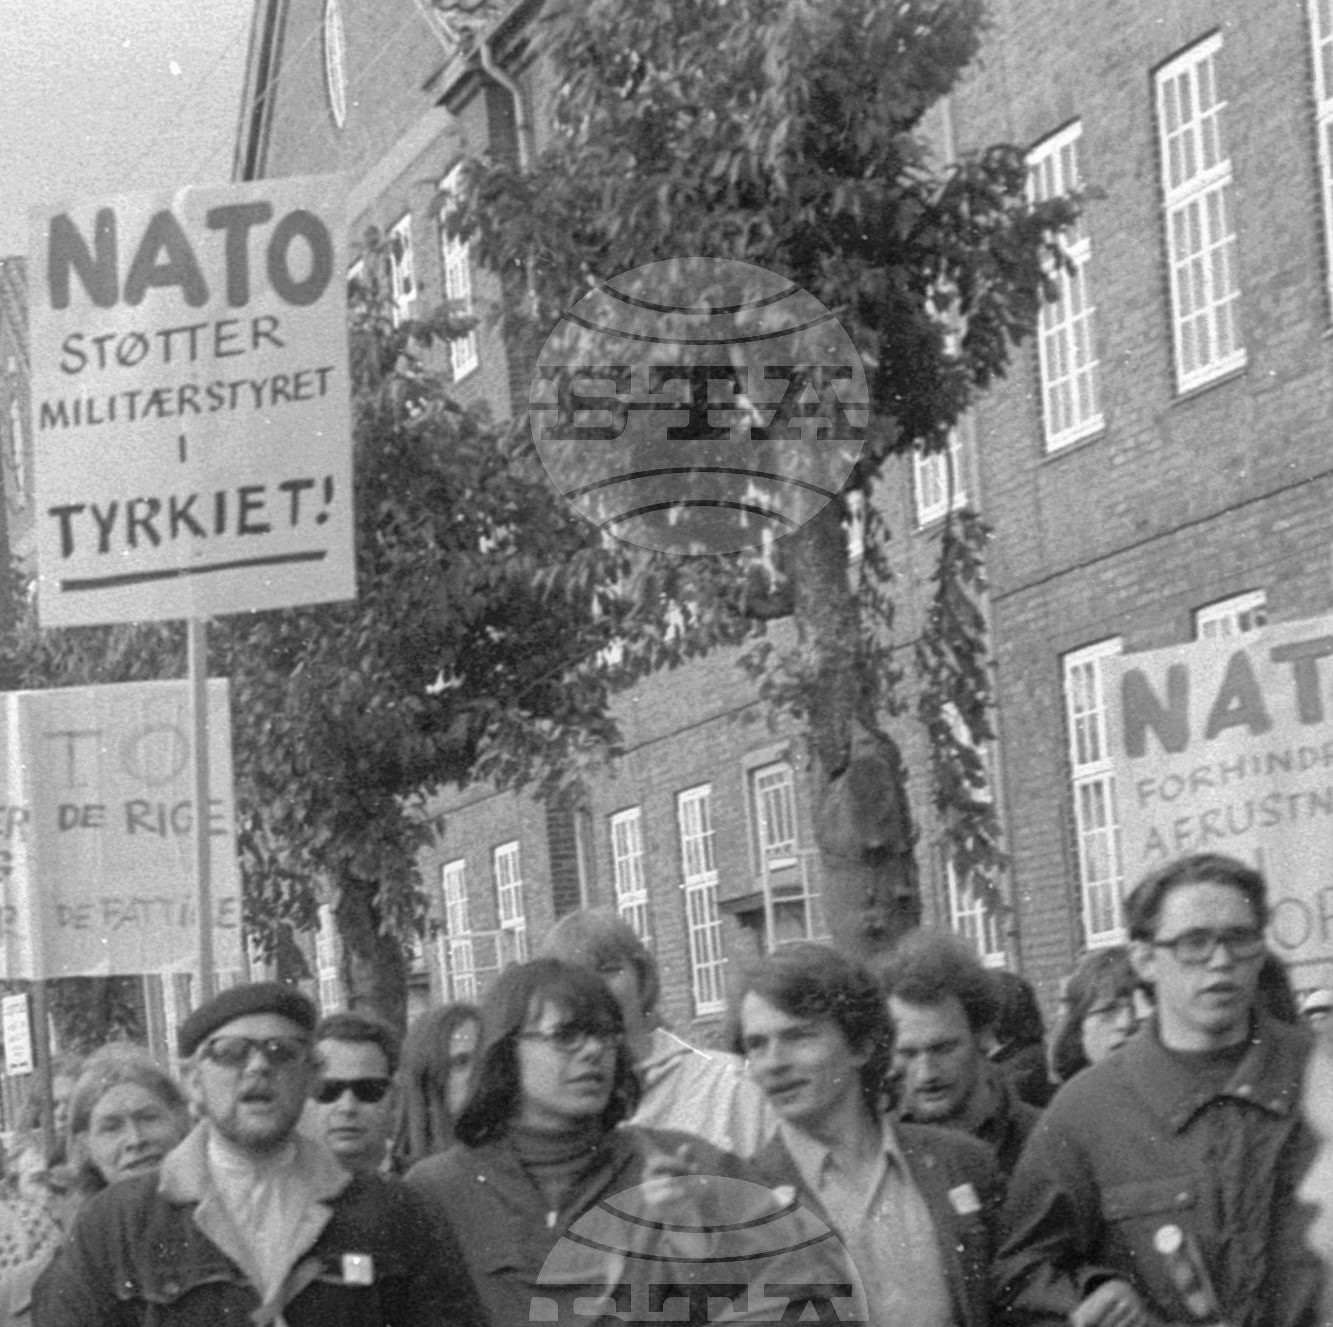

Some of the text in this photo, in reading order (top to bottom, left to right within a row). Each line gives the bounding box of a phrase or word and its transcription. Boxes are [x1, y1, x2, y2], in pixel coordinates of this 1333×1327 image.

[47, 201, 334, 310] NATO
[59, 315, 286, 375] STØTTER
[39, 366, 334, 431] MILITÆRSTYRET
[177, 434, 187, 463] I
[49, 475, 334, 559] TYRKIET!
[57, 803, 107, 833] DE
[97, 896, 239, 931] FATTIE
